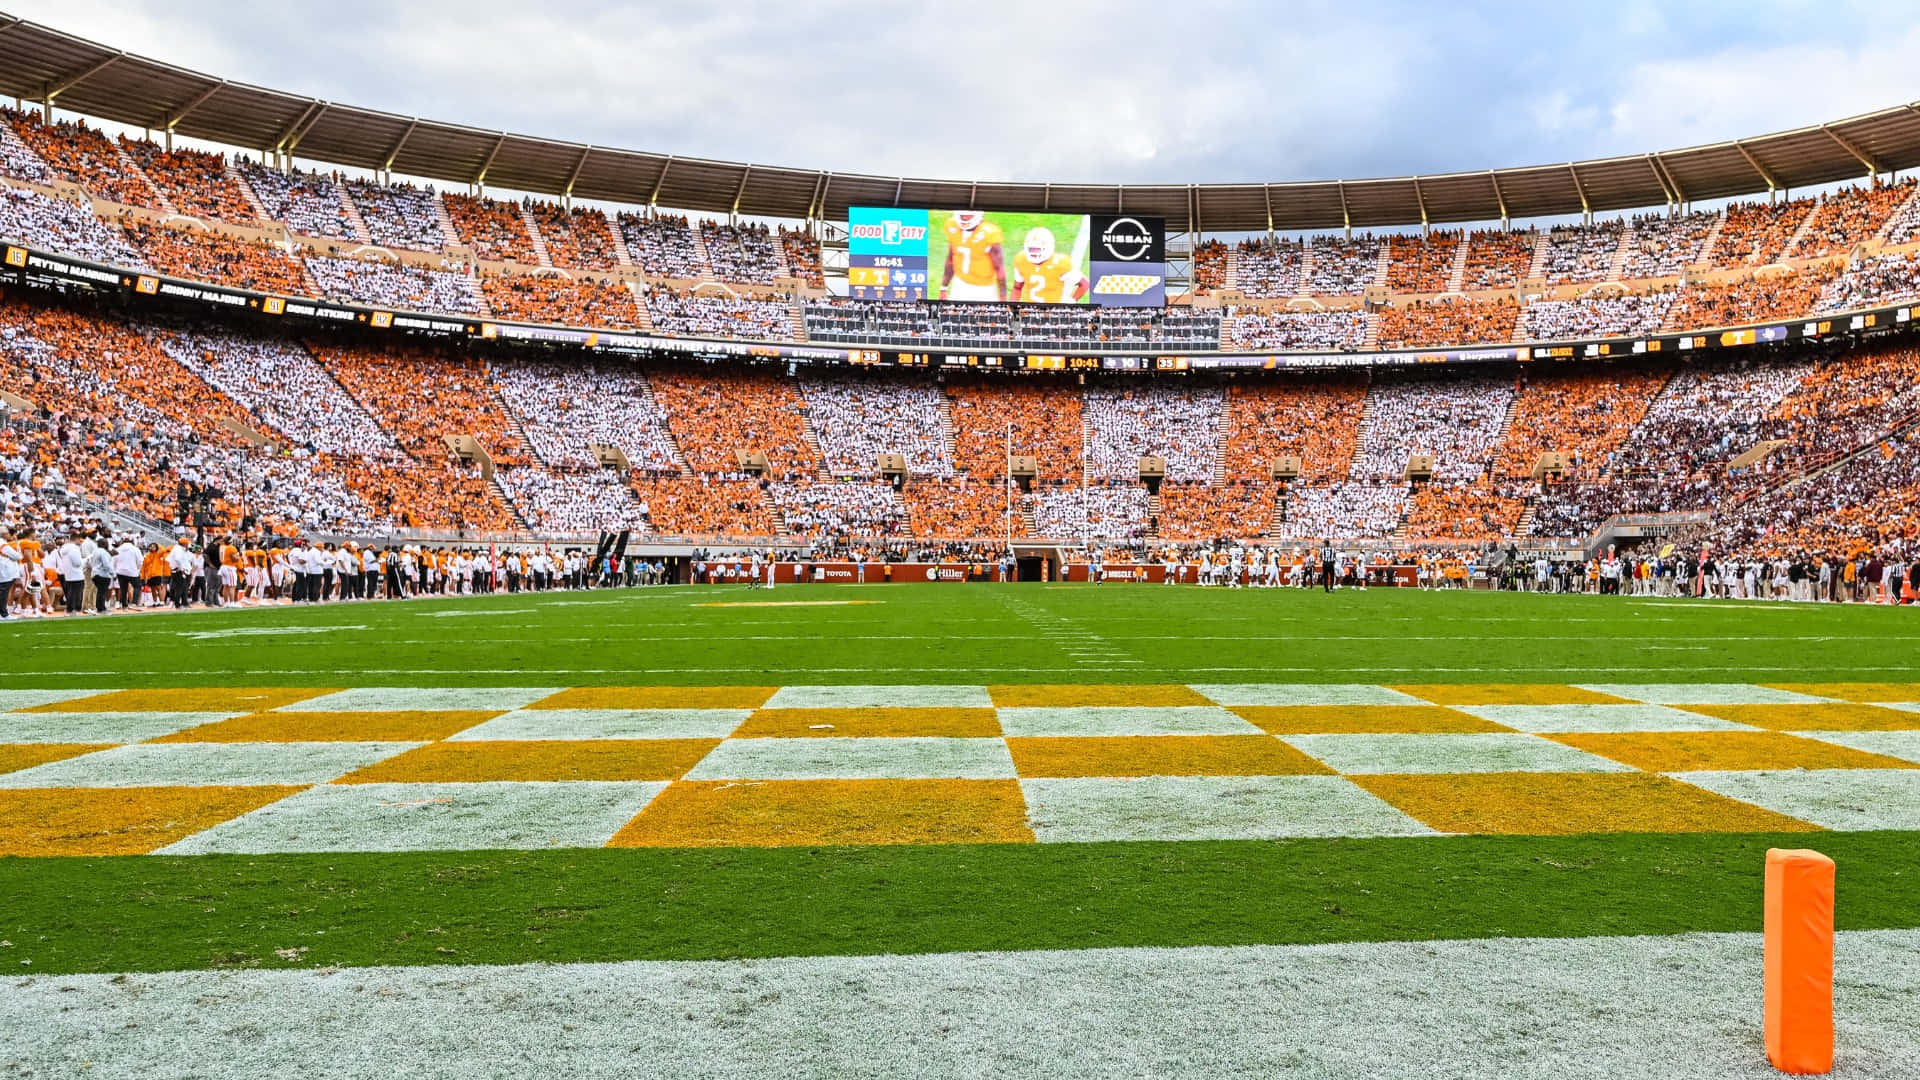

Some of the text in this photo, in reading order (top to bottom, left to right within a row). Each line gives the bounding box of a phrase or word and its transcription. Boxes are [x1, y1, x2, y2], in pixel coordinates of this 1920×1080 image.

[853, 226, 882, 237] FOOD
[901, 227, 924, 239] CITY
[1102, 234, 1152, 244] NISSAN
[12, 250, 120, 284] 16 PEYTON MANNING
[874, 257, 904, 267] 10:41
[858, 271, 866, 282] 7
[910, 273, 925, 284] 10
[202, 291, 247, 306] MAJORS
[502, 326, 532, 339] Harper
[609, 336, 780, 357] PROUD PARTNER OF THE VOLS
[863, 352, 878, 361] 35
[1069, 358, 1099, 368] 10:41
[1121, 357, 1135, 368] 10
[1286, 353, 1447, 367] PROUD PARTNER OF THE VOLS
[1160, 359, 1174, 368] 35
[939, 569, 963, 577] Hiller
